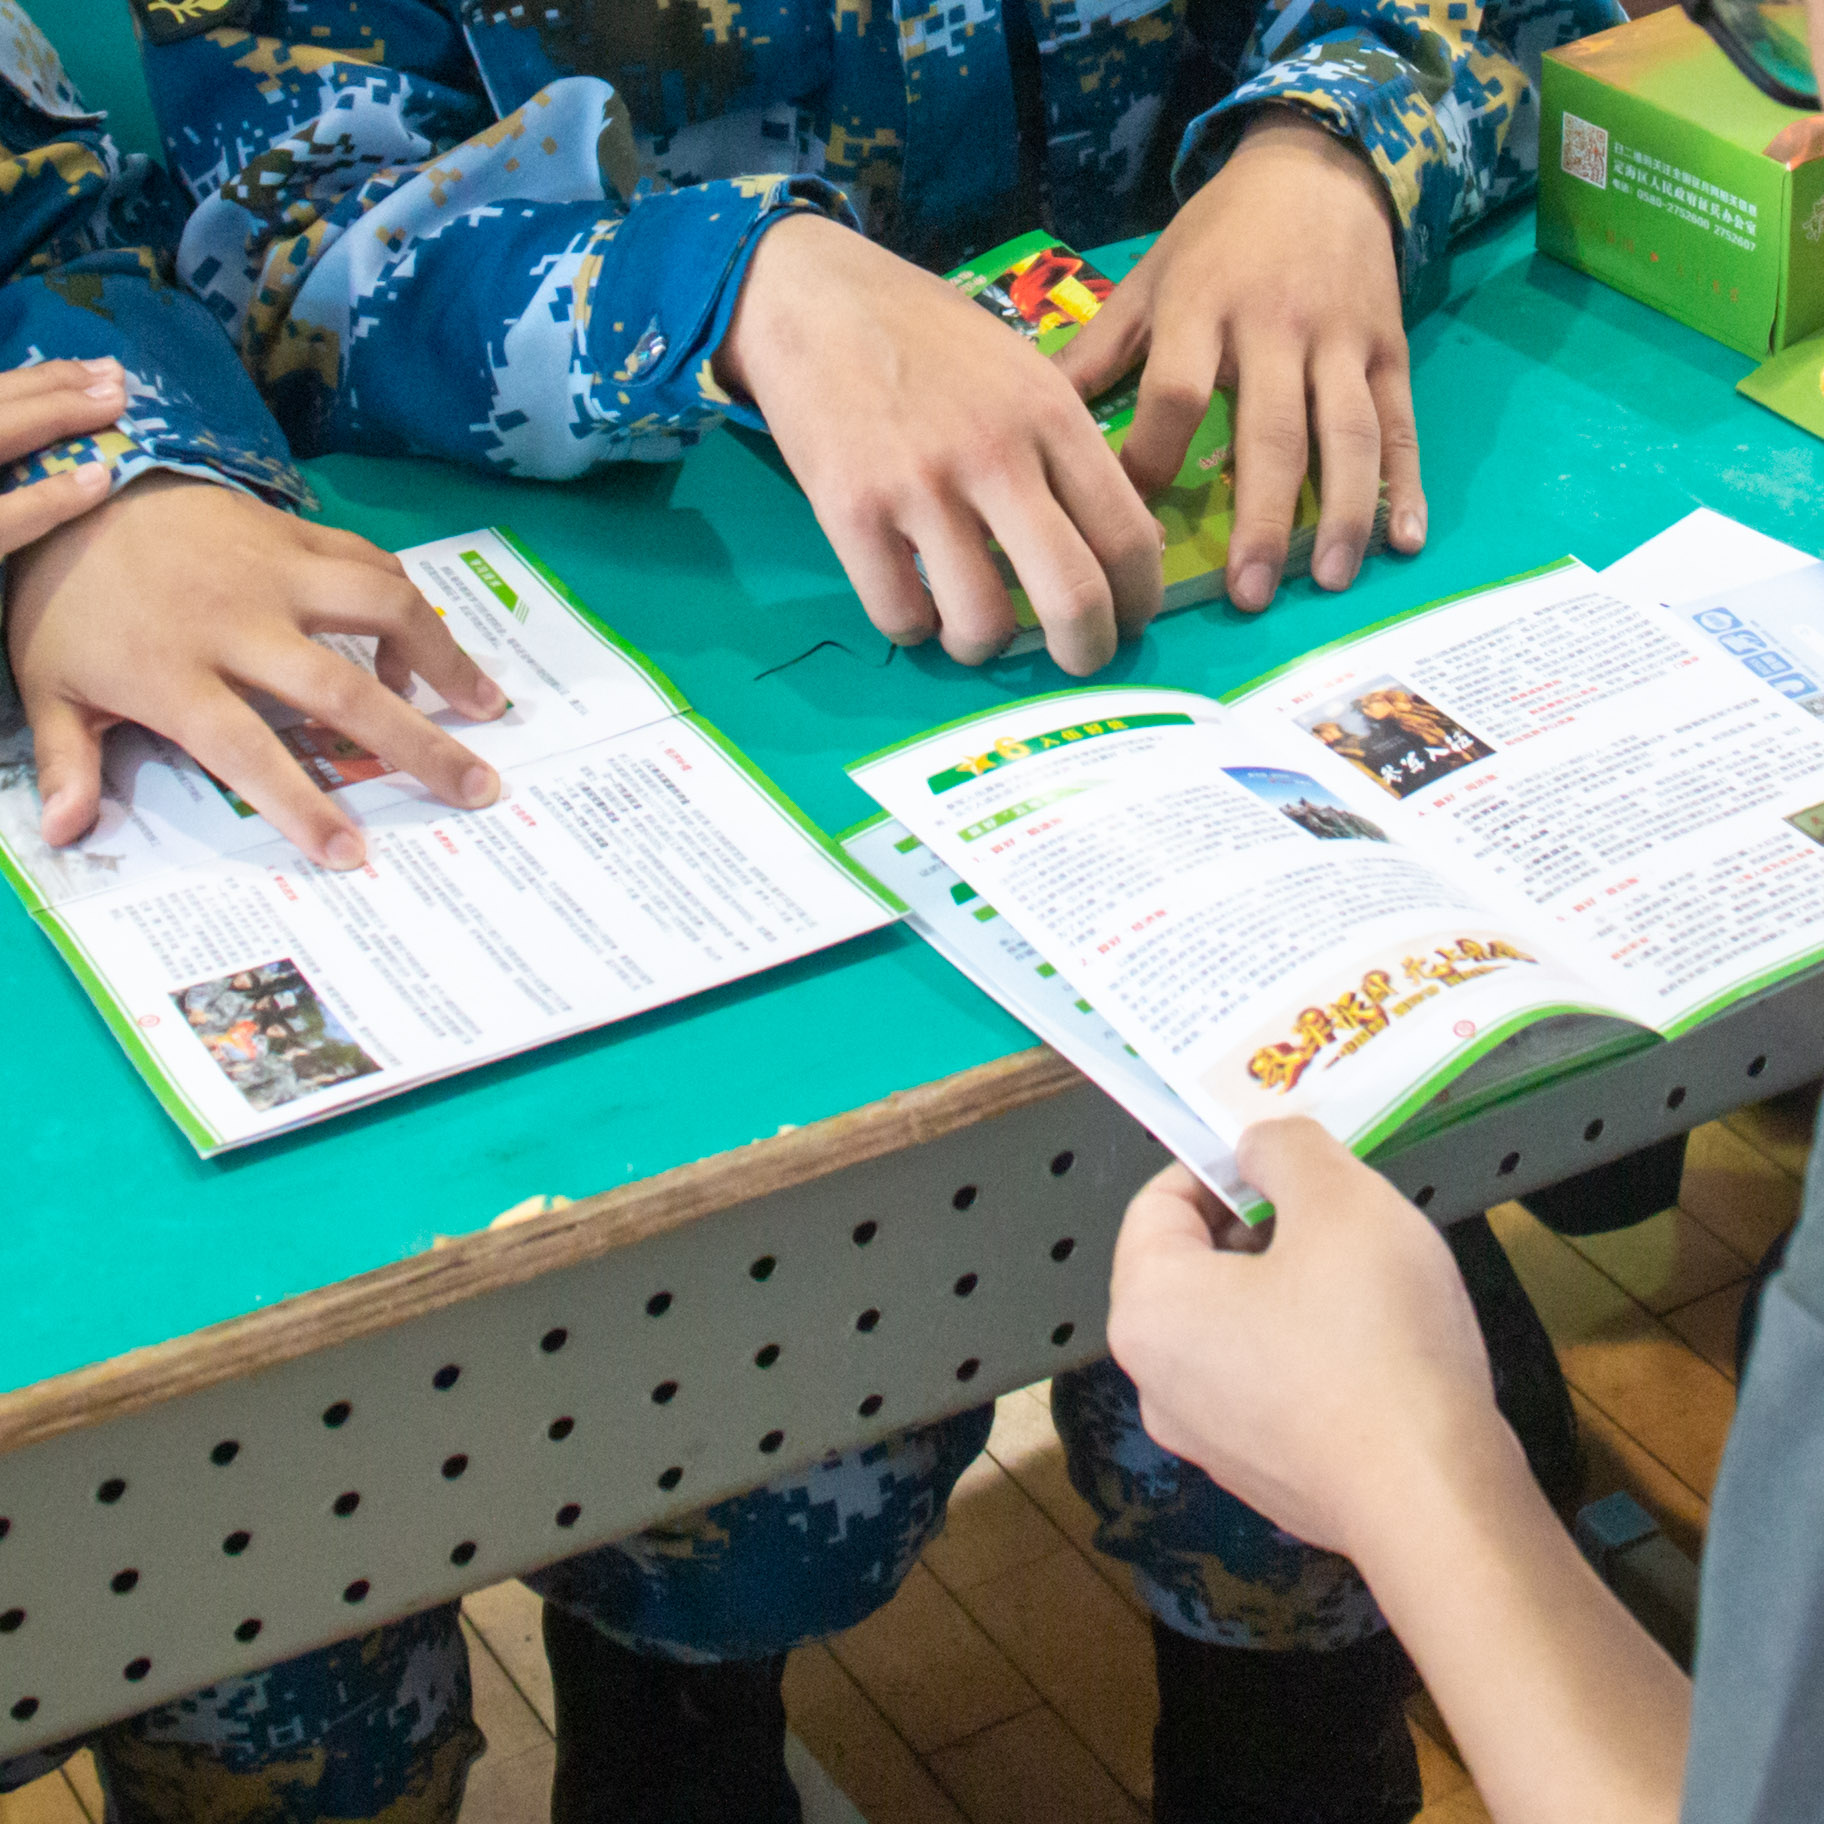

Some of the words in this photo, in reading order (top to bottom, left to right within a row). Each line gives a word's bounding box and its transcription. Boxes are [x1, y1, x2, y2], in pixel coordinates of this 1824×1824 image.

[1637, 189, 1710, 230] 0580-2752600
[1714, 225, 1756, 251] 2752607
[992, 734, 1031, 763] 6
